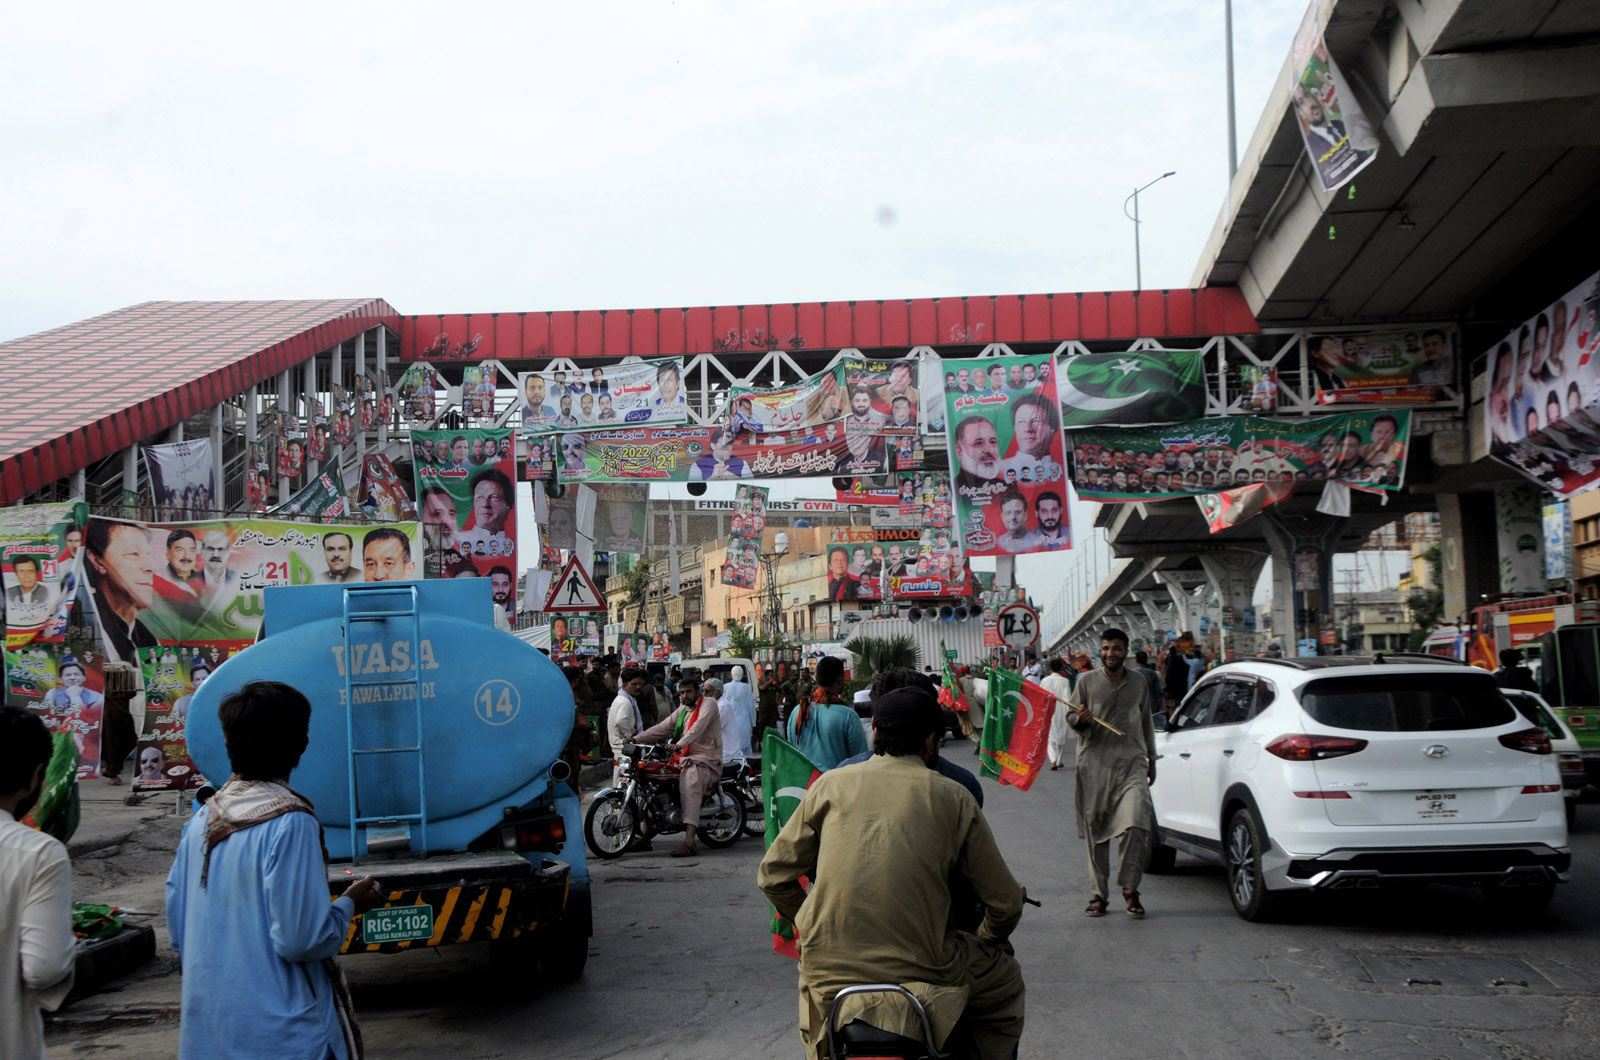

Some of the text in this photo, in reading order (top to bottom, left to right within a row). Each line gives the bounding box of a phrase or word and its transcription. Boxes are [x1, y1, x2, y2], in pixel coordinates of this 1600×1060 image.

[613, 380, 653, 397] کپتان
[636, 398, 649, 408] 21
[954, 392, 1009, 411] جلسہ عام
[621, 446, 650, 459] 2022
[656, 453, 676, 470] 21
[752, 450, 767, 472] چلو
[821, 449, 838, 471] چلو
[766, 449, 783, 475] باغ
[782, 451, 811, 474] لیاقت
[419, 465, 469, 480] جلسہ عام
[699, 500, 736, 509] FITNE
[766, 500, 799, 510] IRST
[803, 501, 834, 511] GYM
[234, 529, 264, 548] نامنظور
[263, 529, 296, 547] حکومت
[265, 562, 288, 579] 21
[900, 579, 941, 595] جلسہ
[562, 639, 575, 652] 21
[331, 640, 440, 677] WASA
[480, 687, 513, 719] 14
[367, 915, 428, 933] RIG-1102
